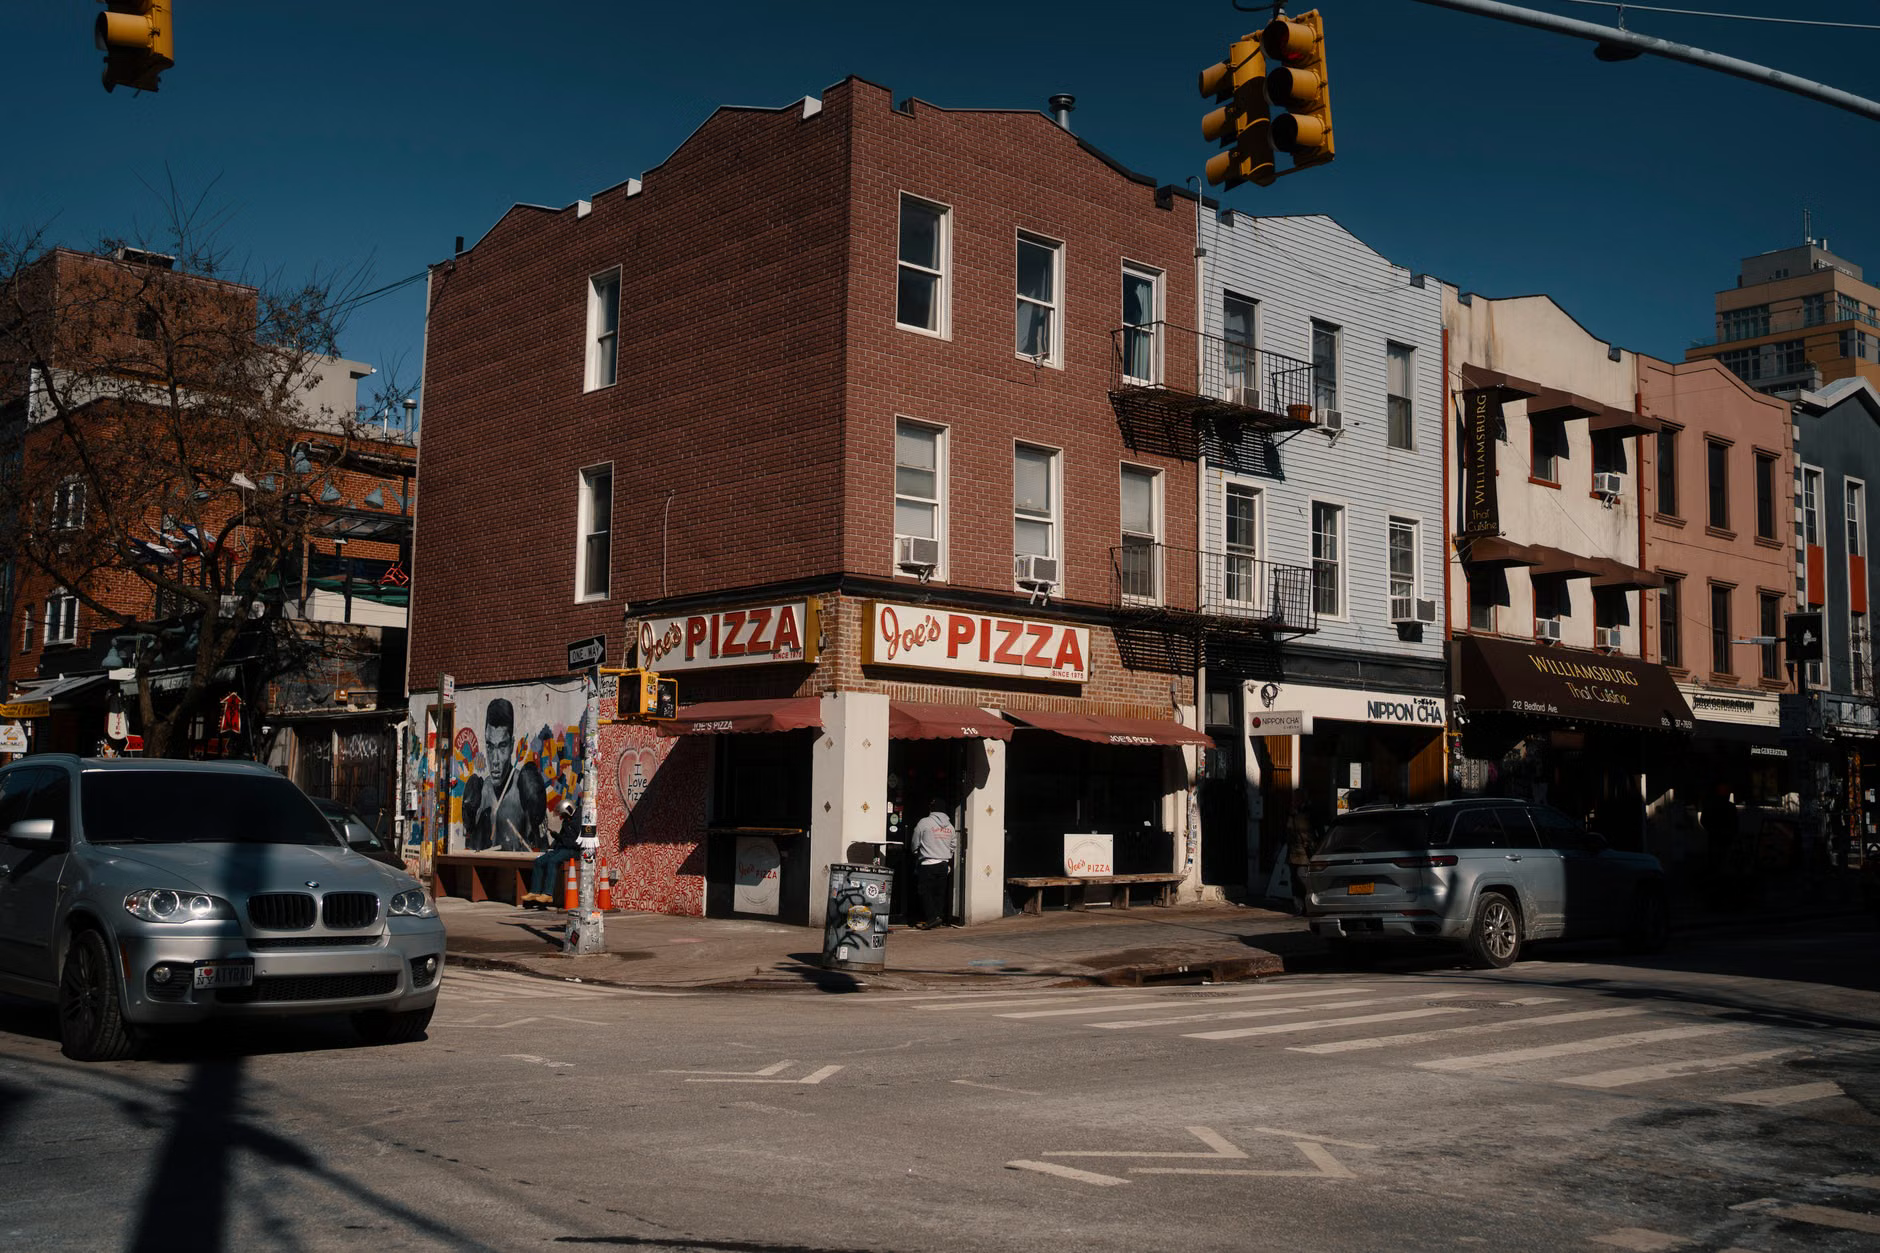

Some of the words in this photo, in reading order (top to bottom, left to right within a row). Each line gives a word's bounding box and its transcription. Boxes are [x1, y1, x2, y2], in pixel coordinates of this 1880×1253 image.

[1475, 394, 1487, 506] WILLIAMSBURG
[1472, 509, 1490, 520] Thai
[1467, 520, 1497, 532] Cuisine
[641, 622, 682, 672] Joe's
[685, 606, 801, 661] PIZZA
[881, 607, 941, 660] Joe's
[947, 614, 1084, 671] PIZZA
[572, 649, 584, 661] ONE
[588, 644, 600, 656] WAY
[772, 651, 789, 660] SINCE
[1052, 670, 1069, 678] SINCE
[1528, 654, 1639, 686] WILLIAMSBURG
[1562, 681, 1591, 700] Thai
[1592, 685, 1630, 705] Cuisine
[1368, 700, 1413, 722] NIPPON
[1417, 705, 1443, 724] CHA
[1512, 700, 1522, 710] 212
[1524, 701, 1546, 713] Bedford
[692, 721, 712, 732] JOE'S
[713, 720, 733, 730] PIZZA
[1262, 717, 1285, 726] NIPPON
[1286, 717, 1299, 725] CHA
[960, 727, 978, 735] 216
[1110, 735, 1133, 744] JOE'S
[634, 764, 642, 775] I
[628, 774, 649, 788] Love
[1068, 857, 1086, 875] Joe's
[1088, 864, 1111, 873] PIZZA
[756, 870, 777, 879] PIZZA
[197, 977, 214, 985] NY
